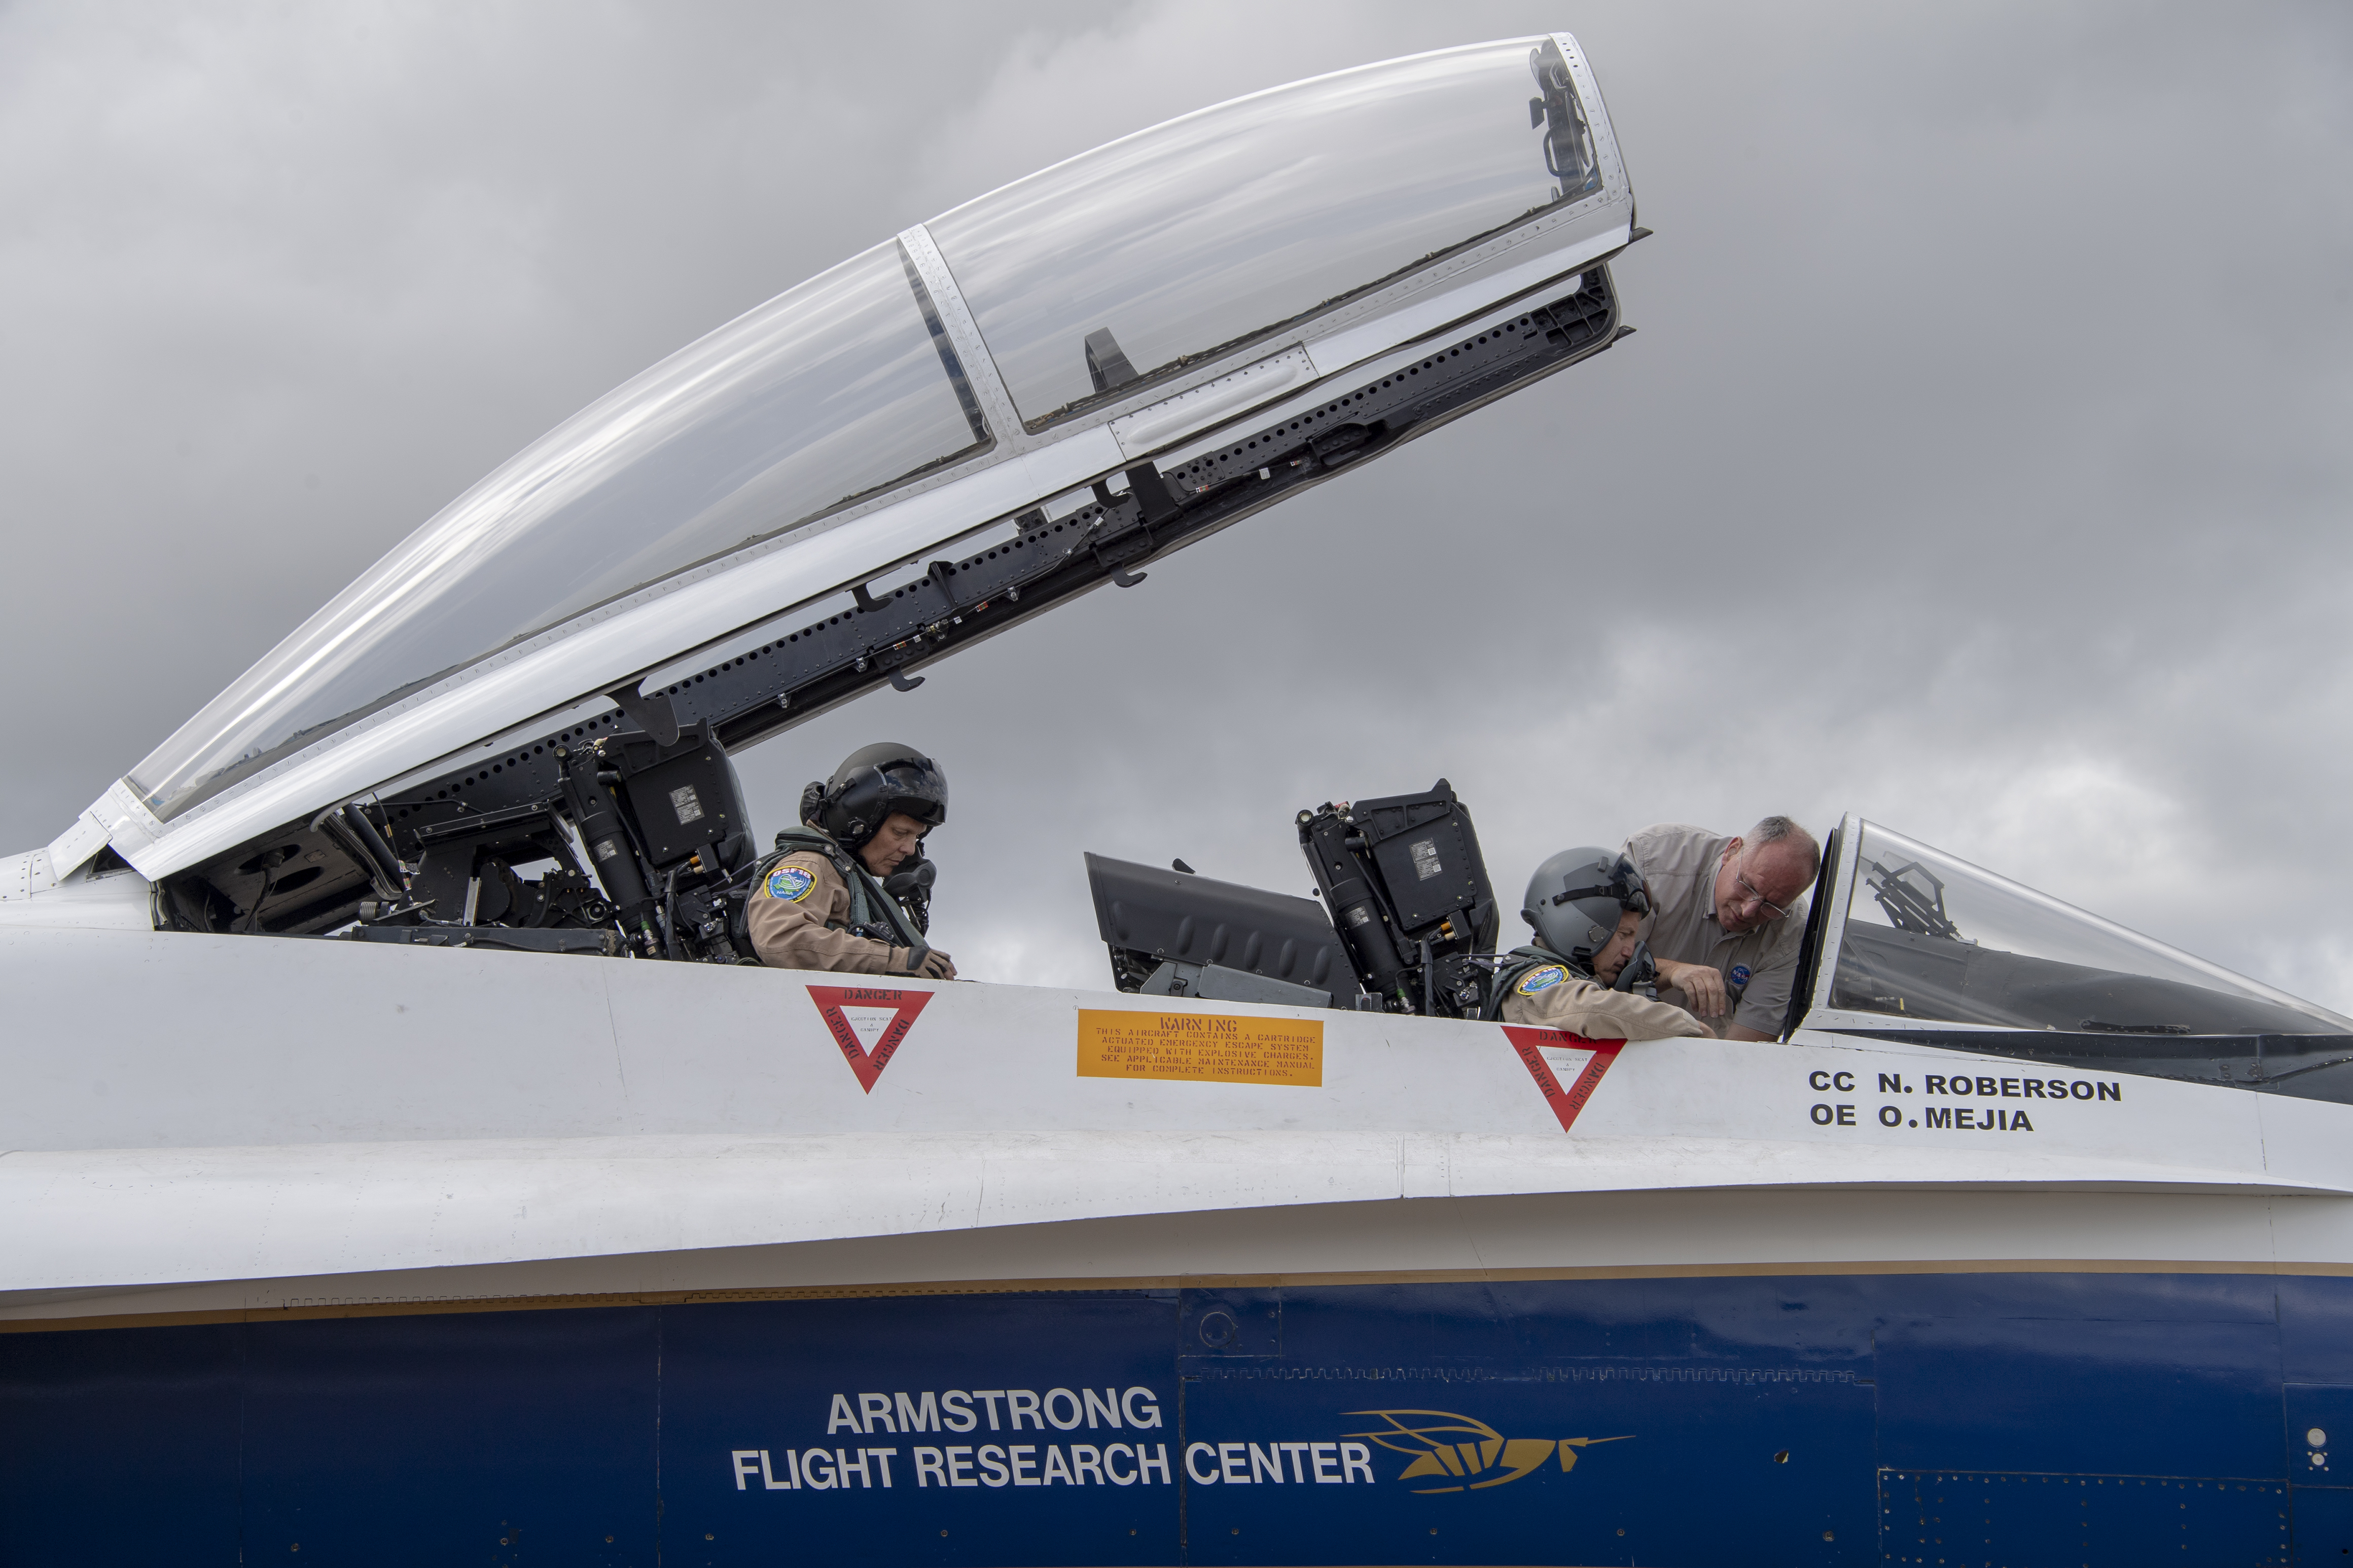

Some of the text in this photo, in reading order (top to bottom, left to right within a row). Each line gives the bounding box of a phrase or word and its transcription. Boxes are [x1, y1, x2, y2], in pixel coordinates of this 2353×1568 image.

[1732, 970, 1749, 980] NASA
[844, 989, 902, 1000] DANGER
[826, 1006, 860, 1059] DANGER
[1160, 1017, 1237, 1033] WARNING
[873, 1019, 910, 1070] DANGER
[1102, 1036, 1308, 1052] ACTUATED EMERGENCY ESCAPE SYSTEM
[1128, 1029, 1179, 1038] AIRCRAFT
[1187, 1031, 1238, 1040] CONTAINS
[1258, 1034, 1315, 1043] CARTRIDGE
[1101, 1054, 1315, 1069] SEE APPLICABLE MAINTENANCE MANUAL
[1108, 1046, 1159, 1054] EQUIPPED
[1198, 1049, 1257, 1059] EXPLOSIVE
[1264, 1051, 1313, 1060] CHARGES.
[1153, 1065, 1204, 1074] COMPLETE
[1213, 1067, 1293, 1077] INSTRUCTIONS.
[1522, 1046, 1556, 1098] DANGER
[1569, 1062, 1605, 1110] DANGER
[1809, 1070, 2122, 1102] CC N. ROBERSON
[1810, 1104, 1856, 1126] OE
[827, 1387, 1162, 1434] ARMSTRONG
[732, 1442, 1375, 1490] FLIGHT RESEARCH CENTER
